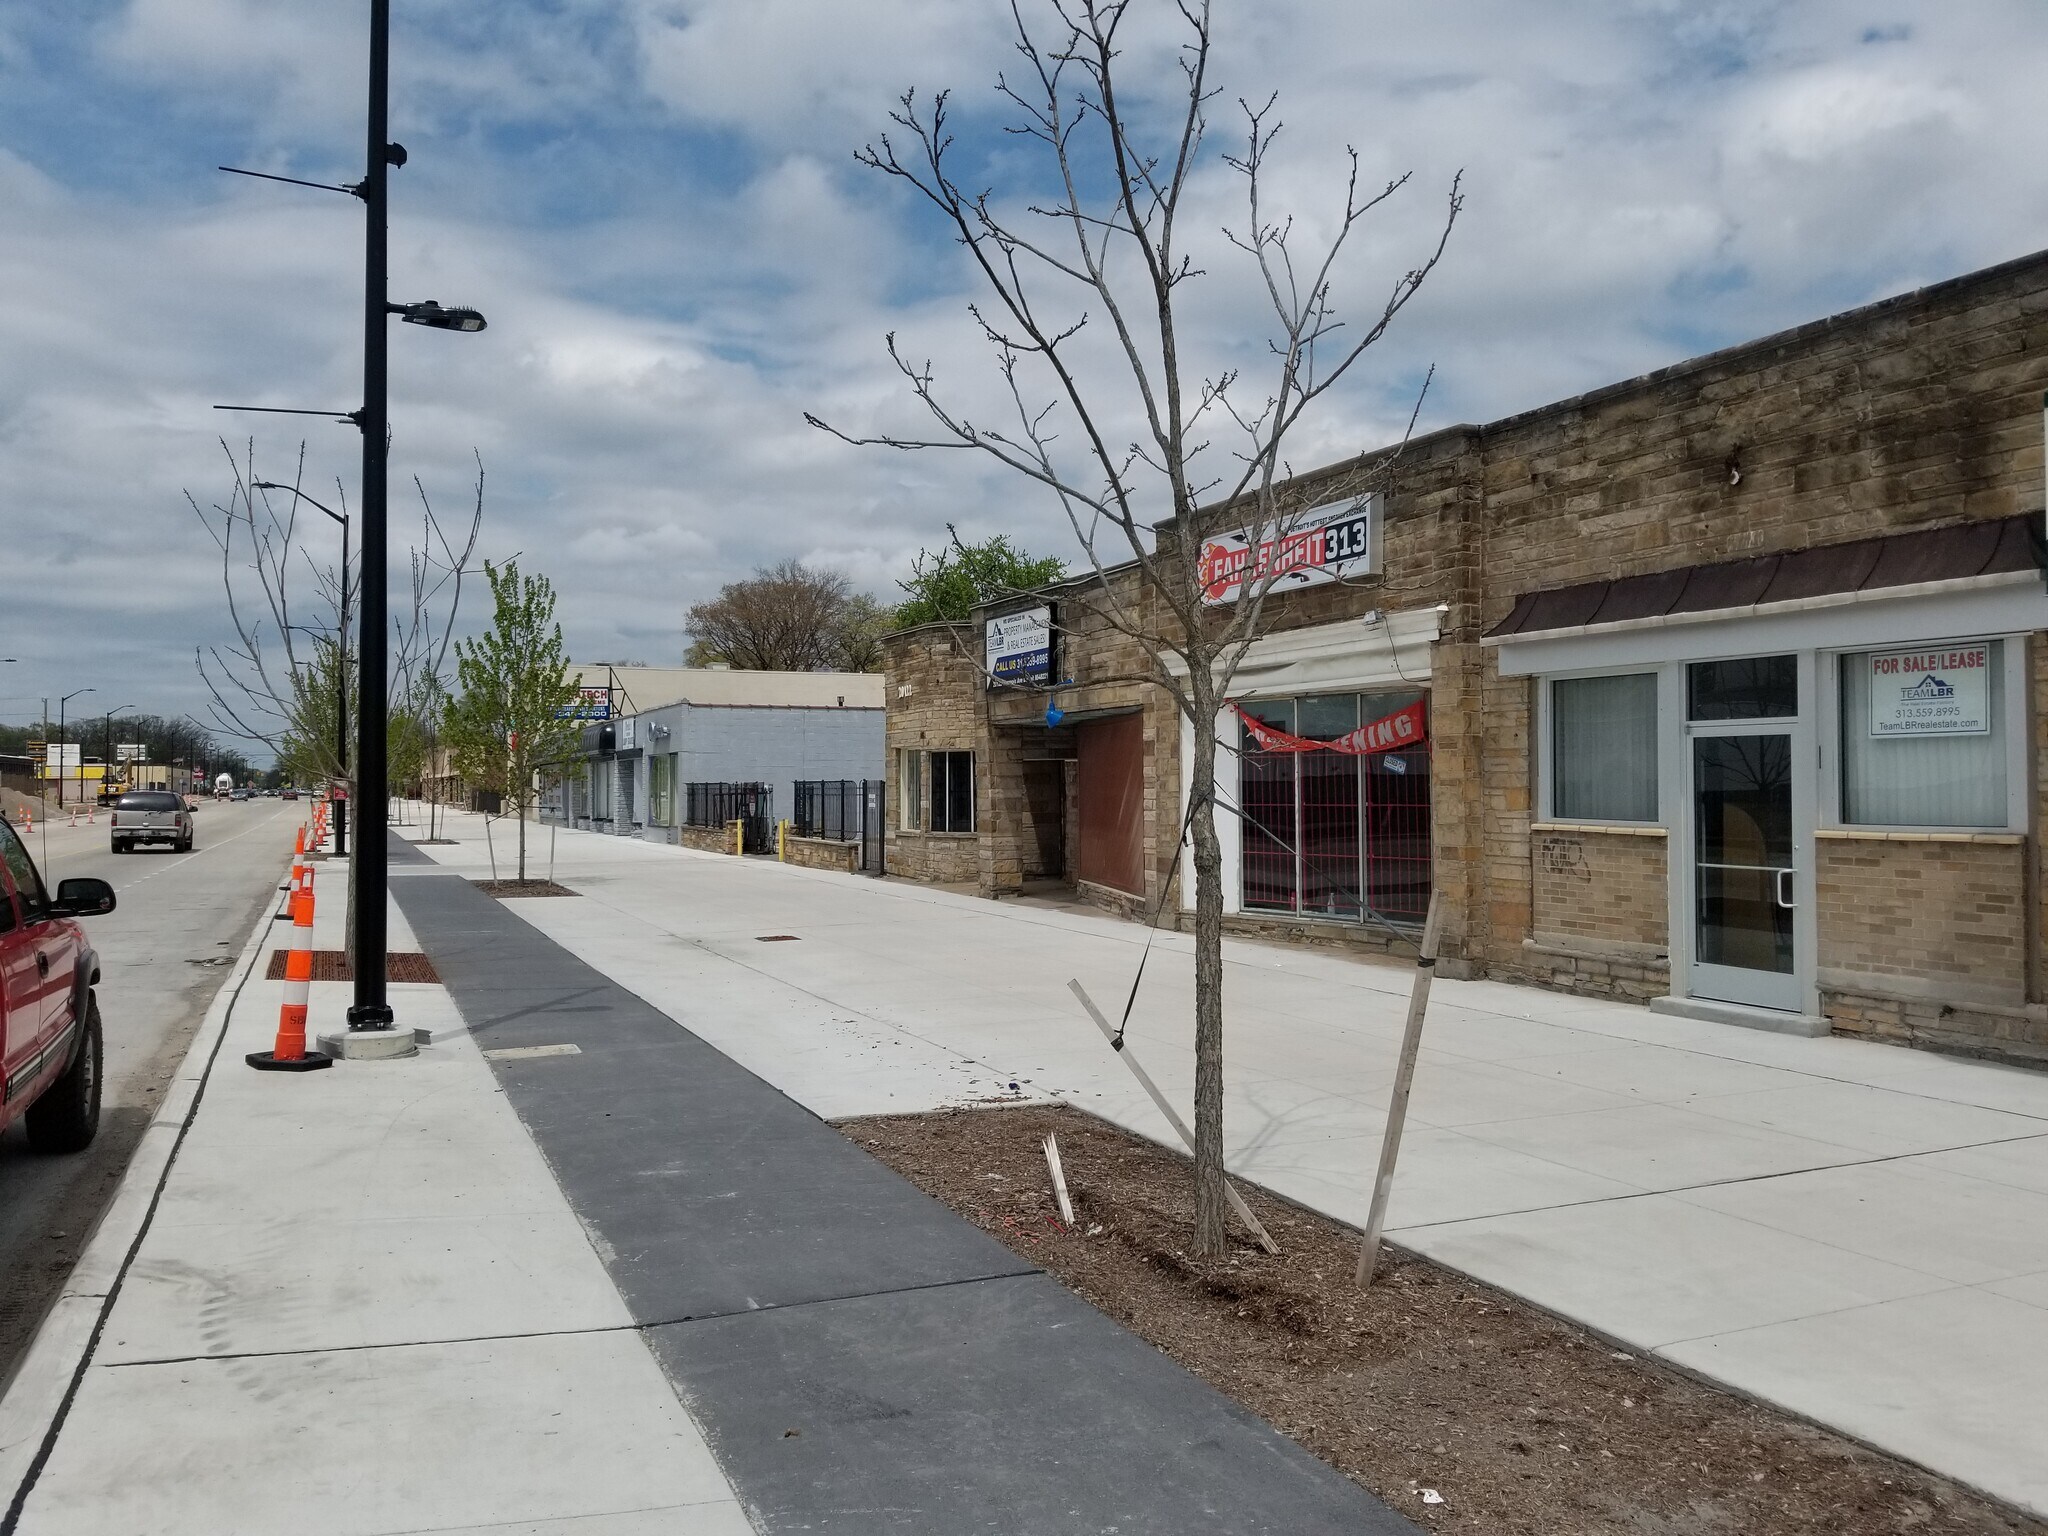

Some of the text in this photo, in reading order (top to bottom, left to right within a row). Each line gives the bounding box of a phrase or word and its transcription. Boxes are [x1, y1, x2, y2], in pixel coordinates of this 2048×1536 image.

[1214, 521, 1365, 586] FAHENHEIT 313
[1004, 625, 1021, 637] PROPERTY
[996, 661, 1008, 672] CALL
[1009, 659, 1016, 670] US
[1873, 651, 1985, 675] FOR SALE/LEASE
[1901, 687, 1954, 699] TEAMLBR
[1895, 706, 1960, 719] 313.559.8995
[1879, 719, 1979, 731] TeamLBRrealestate.com
[290, 1015, 305, 1025] SB
